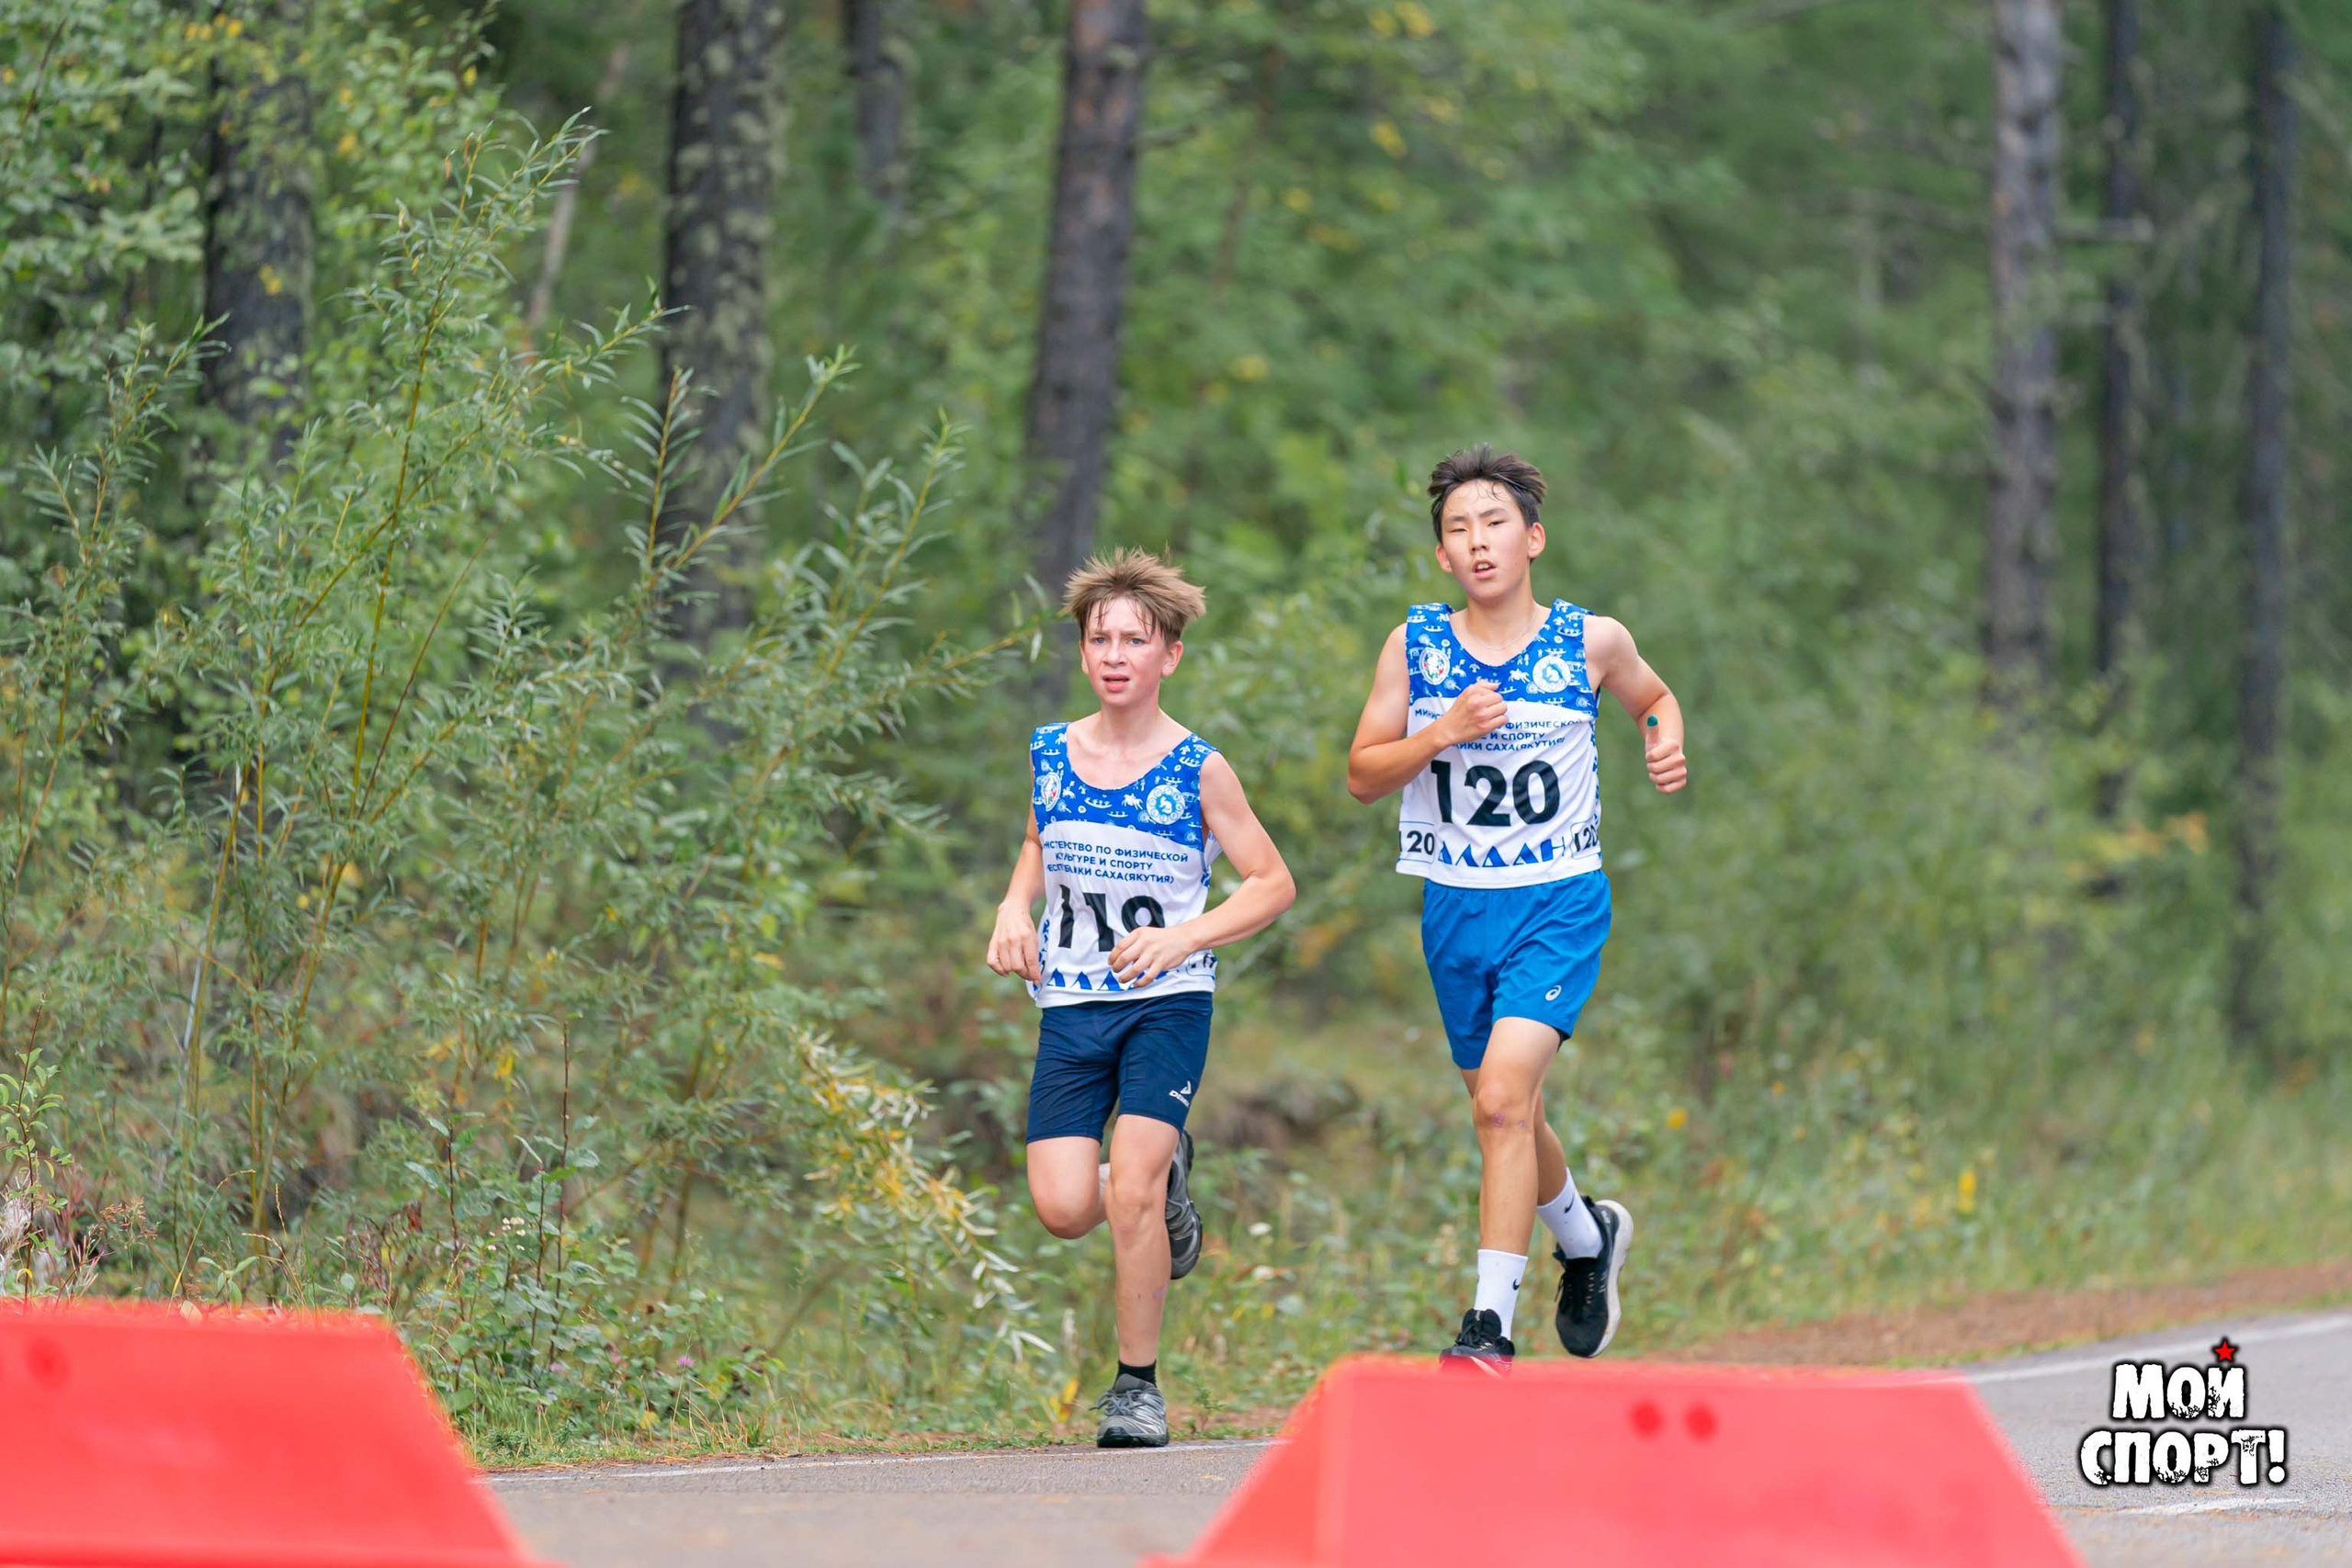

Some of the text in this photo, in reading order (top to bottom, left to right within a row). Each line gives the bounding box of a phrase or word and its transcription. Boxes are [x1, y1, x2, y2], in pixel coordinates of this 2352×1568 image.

[1490, 731, 1498, 740] И
[1430, 760, 1560, 827] 120
[1096, 845, 1112, 854] ПО
[1114, 848, 1189, 863] ФИЗИЧЕСКОЙ
[1099, 857, 1106, 866] И
[1110, 859, 1153, 870] СПОРТУ
[1094, 869, 1174, 884] САХА(ЯКУТИЯ)
